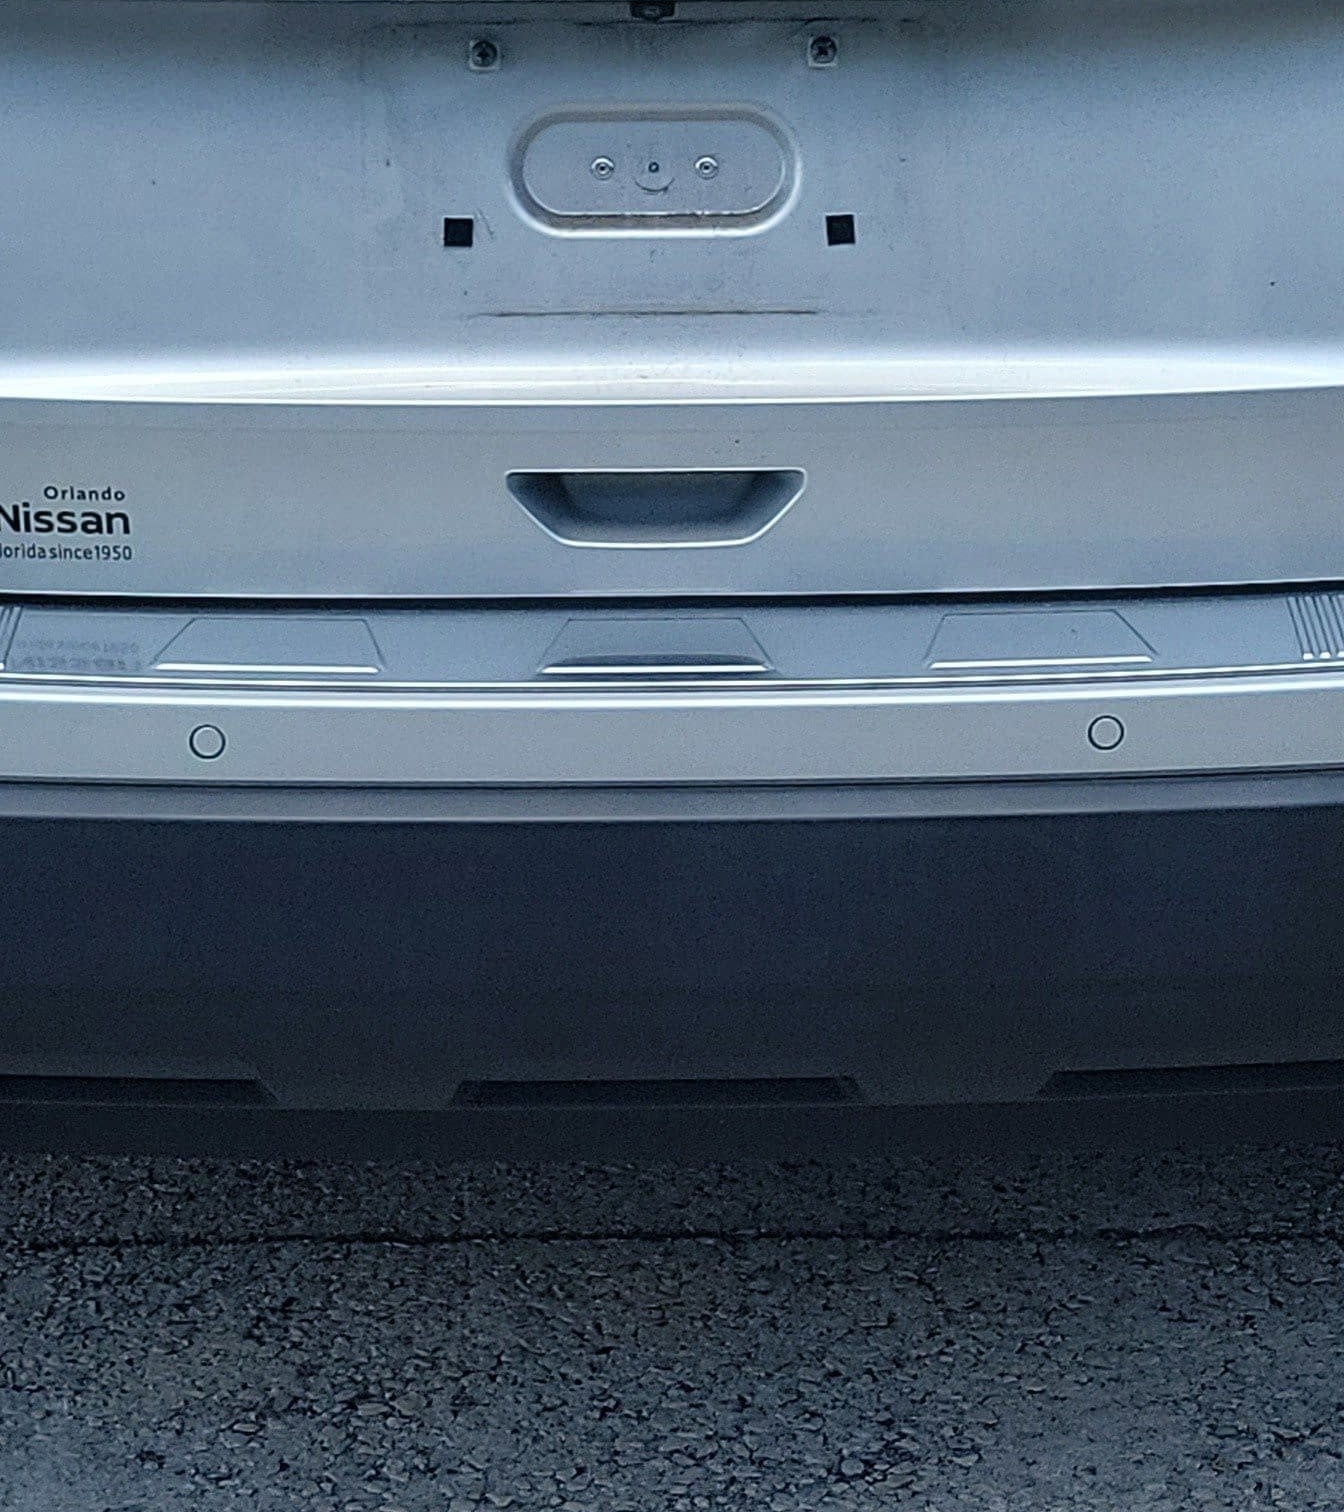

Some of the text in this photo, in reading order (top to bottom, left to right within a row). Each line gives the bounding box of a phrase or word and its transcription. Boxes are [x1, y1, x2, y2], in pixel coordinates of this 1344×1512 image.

[43, 486, 126, 501] Orlando
[50, 543, 93, 560] since
[94, 545, 133, 561] 1950
